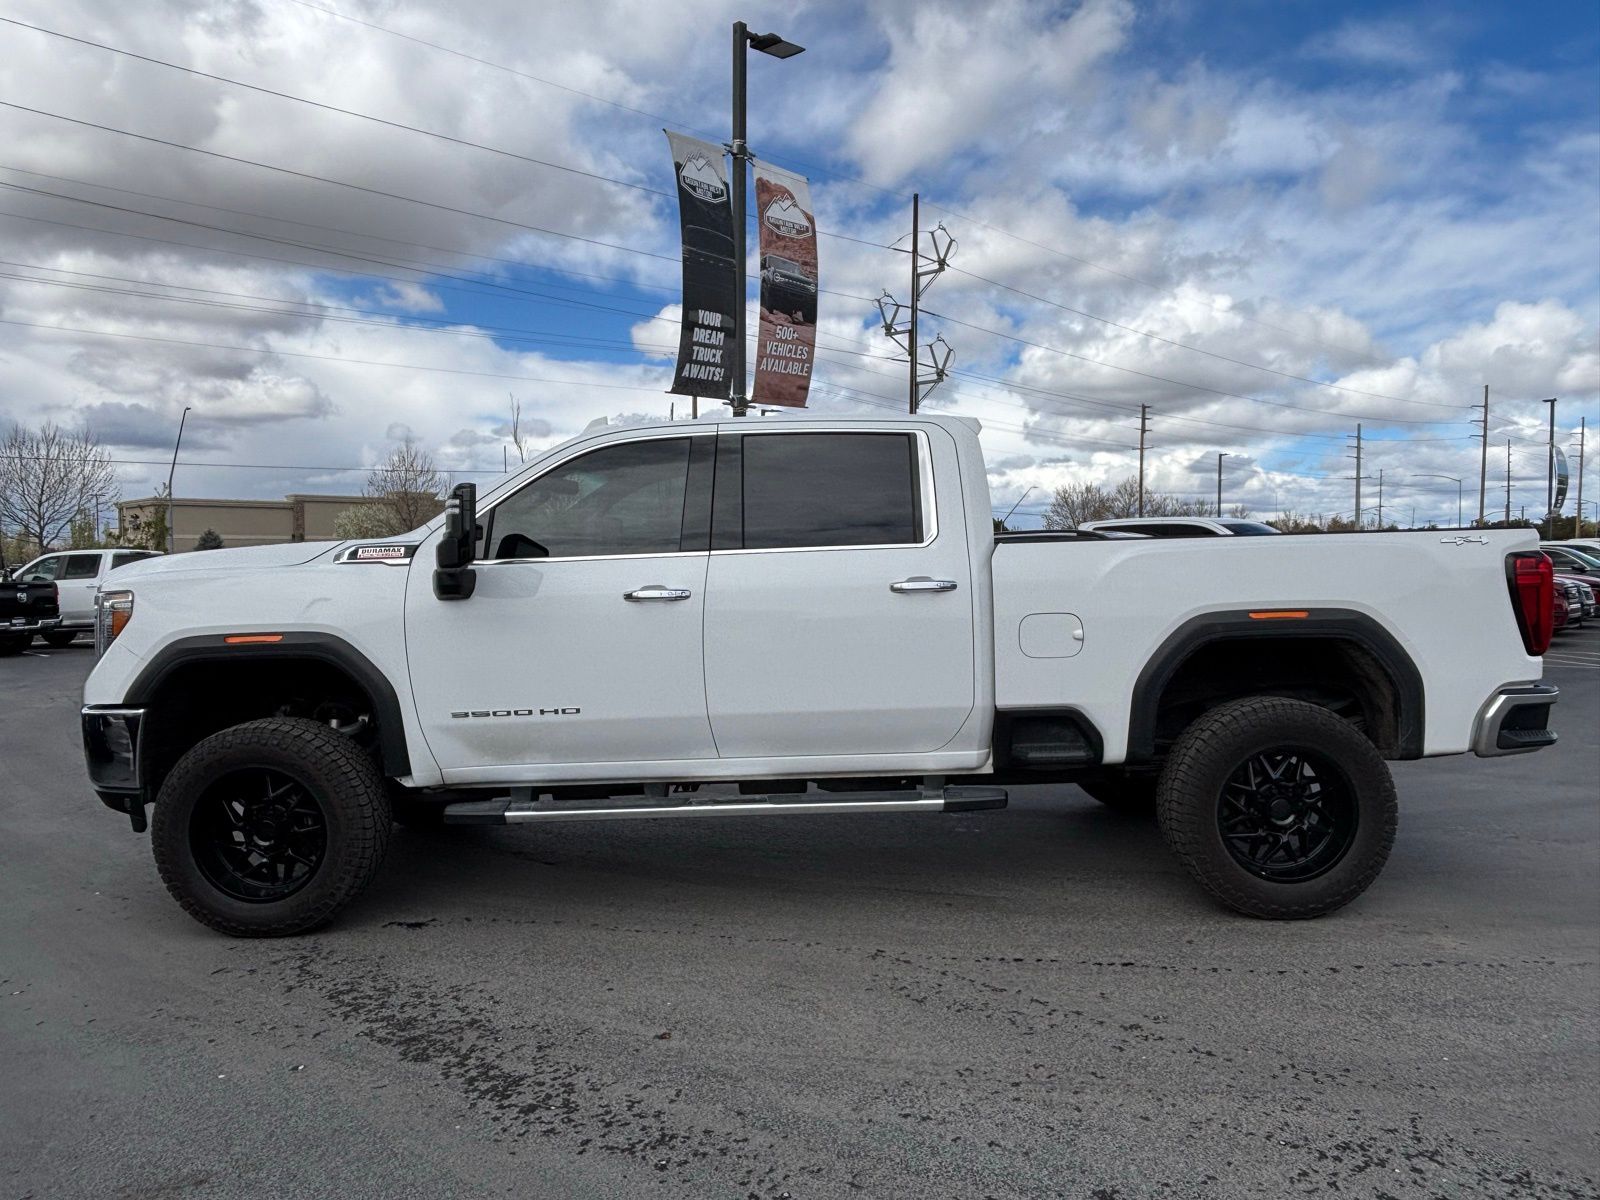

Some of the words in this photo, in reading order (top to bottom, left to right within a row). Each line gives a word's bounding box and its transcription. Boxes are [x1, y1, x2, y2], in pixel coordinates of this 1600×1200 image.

[794, 223, 807, 231] WEST
[698, 309, 722, 328] YOUR
[692, 327, 725, 346] DREAM
[775, 325, 799, 340] 500+
[692, 346, 723, 364] TRUCK
[766, 341, 809, 360] VEHICLES
[682, 363, 724, 381] AWAITS!
[760, 358, 810, 377] AVAILABLE
[451, 709, 533, 718] 3500
[539, 707, 581, 715] HD
